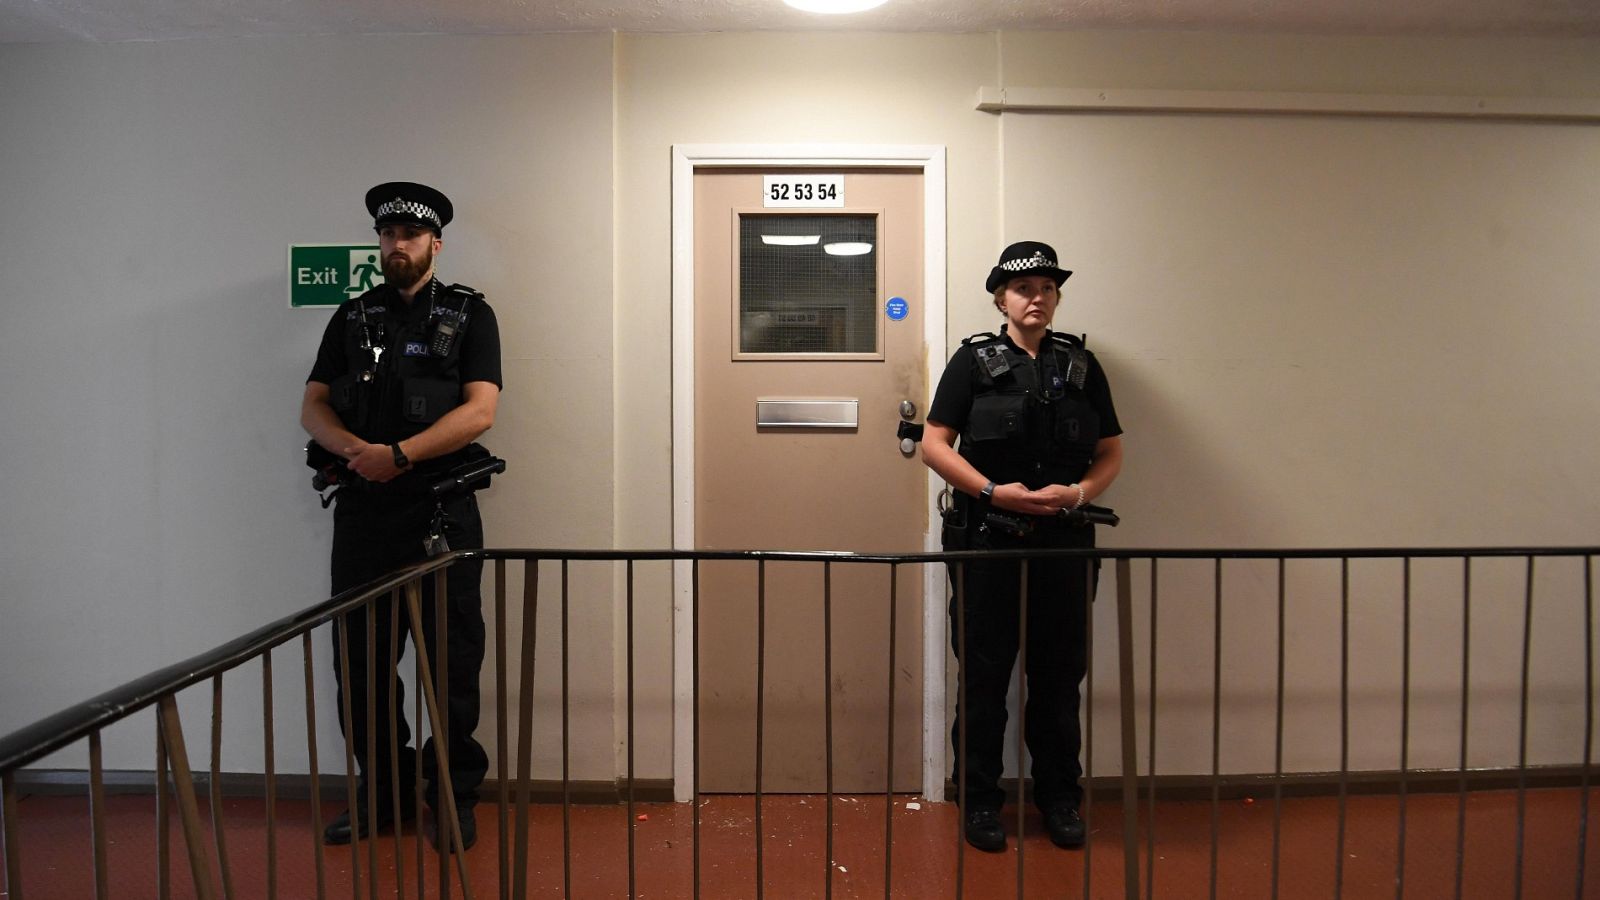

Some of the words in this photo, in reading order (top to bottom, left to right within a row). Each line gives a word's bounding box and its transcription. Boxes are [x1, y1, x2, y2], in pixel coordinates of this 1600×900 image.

[771, 183, 790, 200] 52
[794, 183, 813, 200] 53
[818, 183, 837, 200] 54
[297, 267, 338, 285] Exit
[405, 343, 428, 356] POLI
